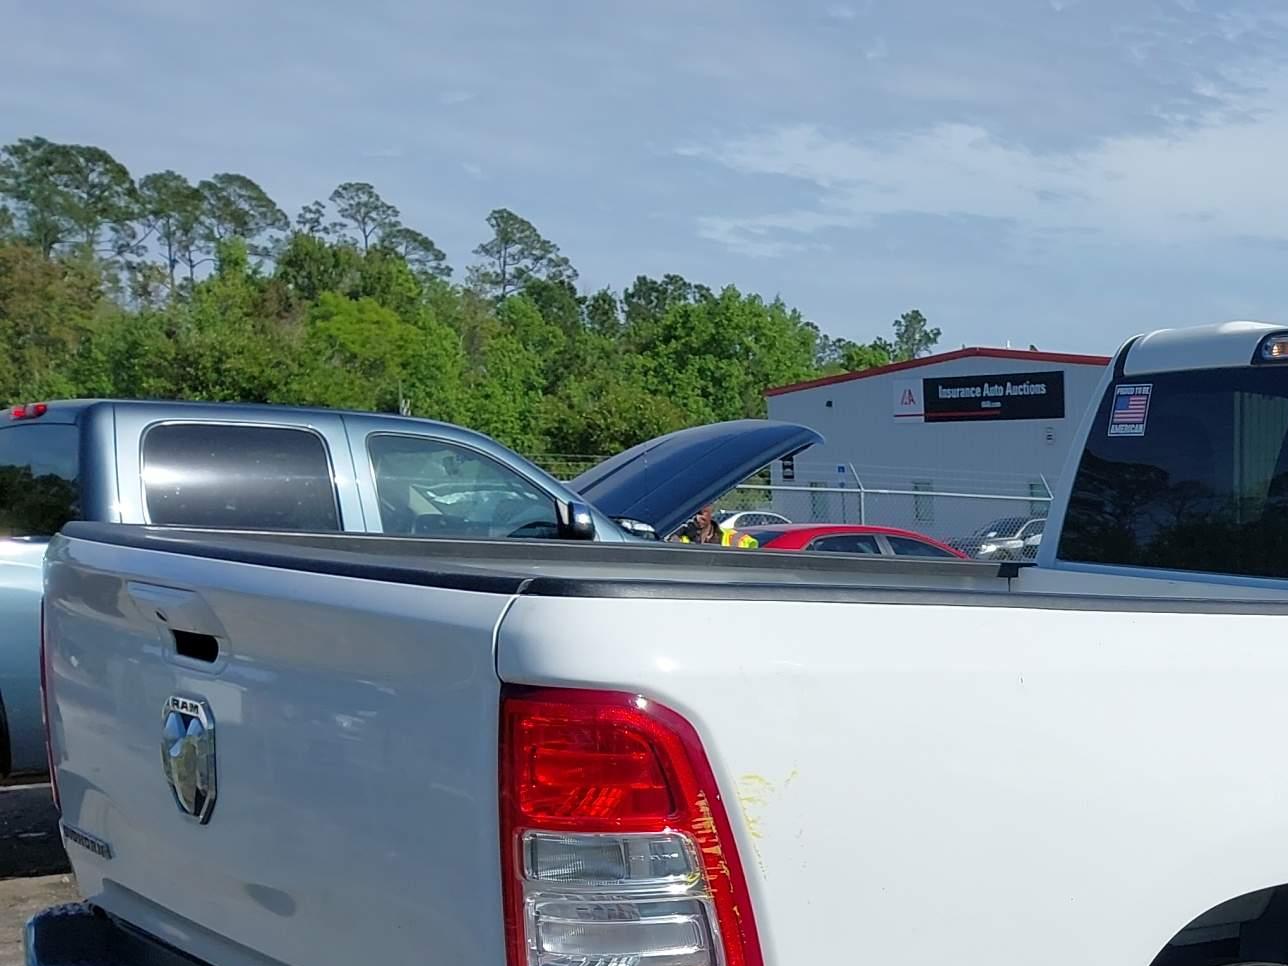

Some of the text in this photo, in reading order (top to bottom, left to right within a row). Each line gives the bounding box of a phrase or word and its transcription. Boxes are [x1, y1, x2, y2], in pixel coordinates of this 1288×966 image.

[938, 380, 1047, 399] Insurance Auto Auctions
[1111, 424, 1145, 433] AMERICAN
[172, 698, 200, 715] RAM
